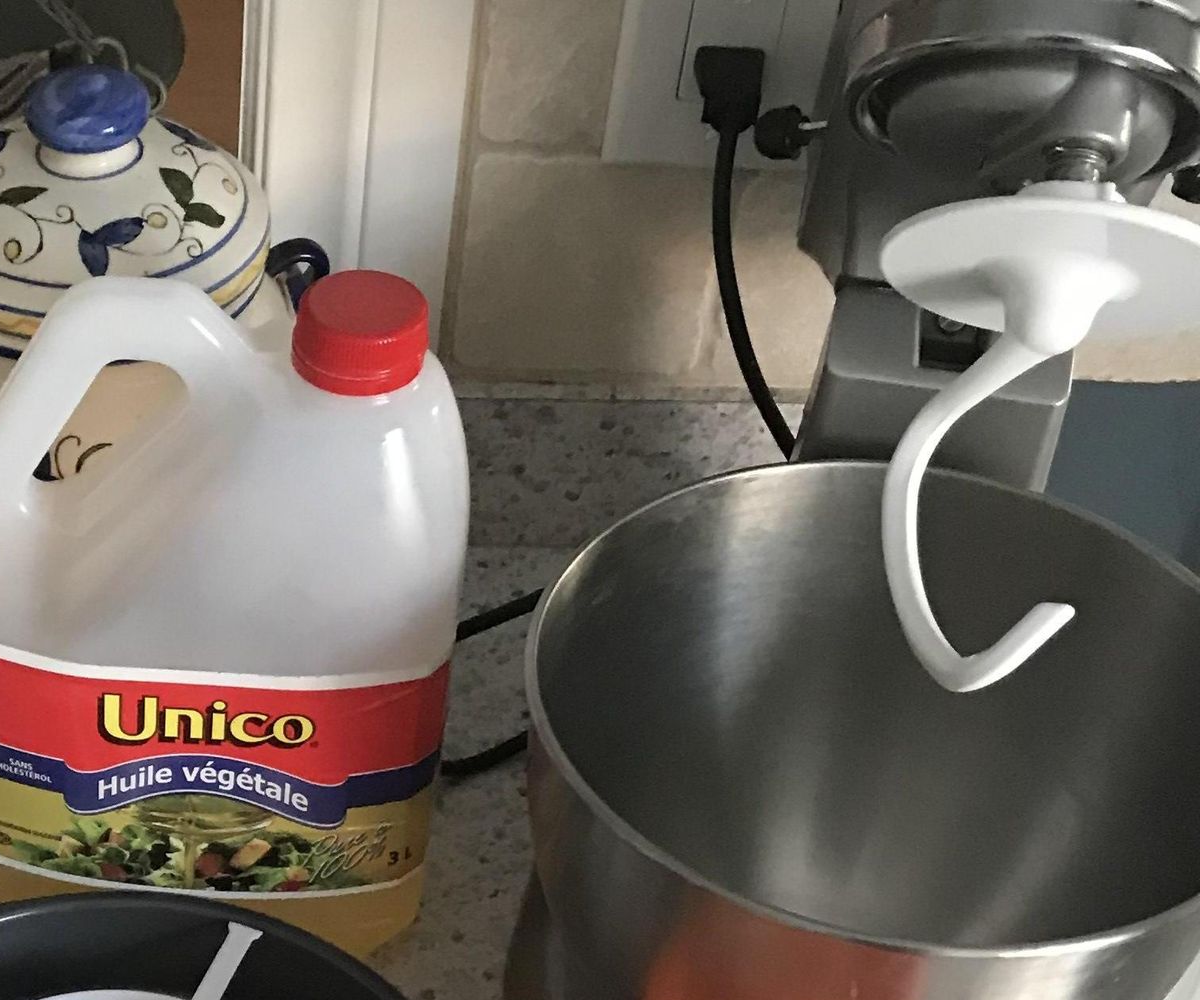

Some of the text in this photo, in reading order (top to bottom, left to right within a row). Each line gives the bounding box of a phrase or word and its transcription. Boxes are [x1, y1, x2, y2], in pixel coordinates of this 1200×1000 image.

[97, 692, 315, 748] Unico
[9, 757, 33, 771] SANS
[97, 760, 310, 813] Huile végétale
[387, 850, 400, 867] 3
